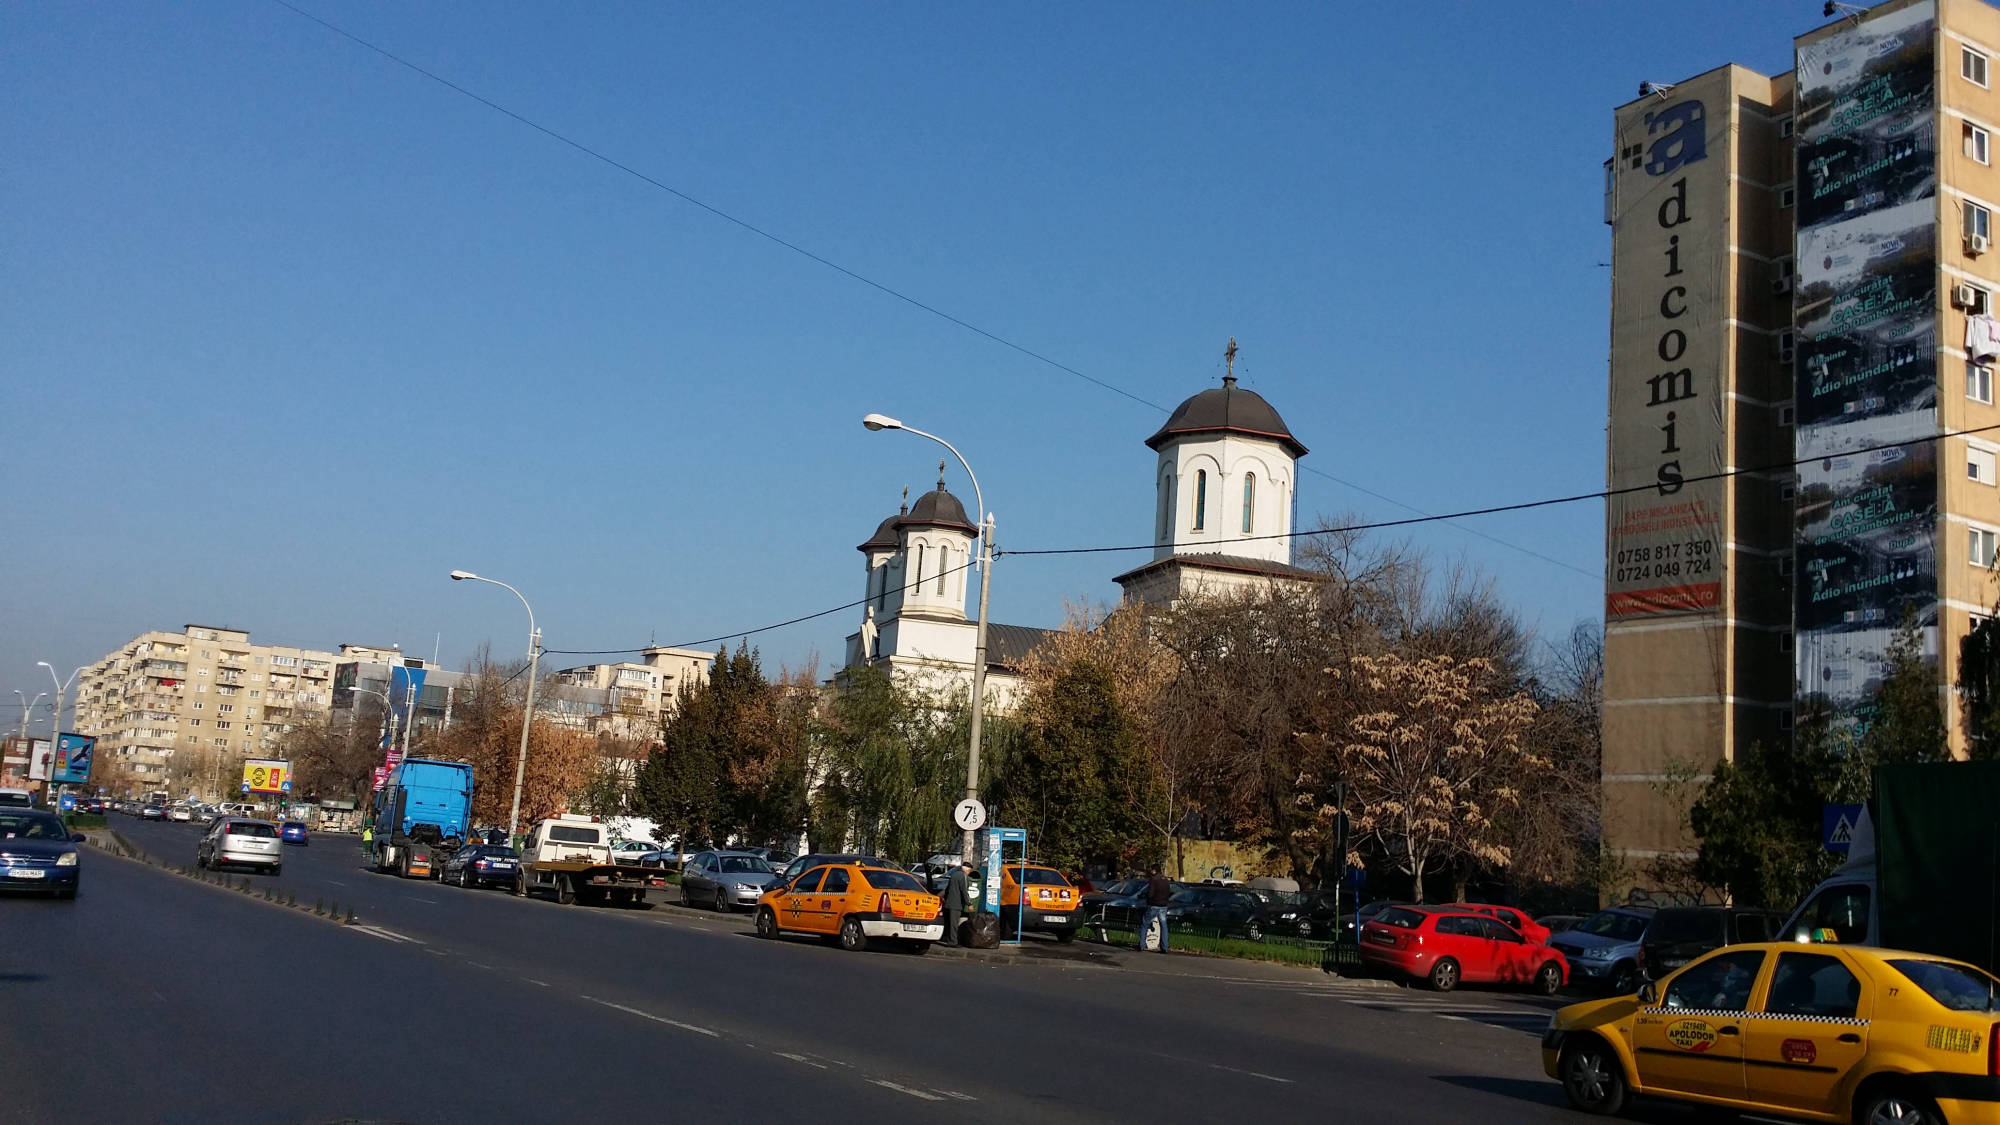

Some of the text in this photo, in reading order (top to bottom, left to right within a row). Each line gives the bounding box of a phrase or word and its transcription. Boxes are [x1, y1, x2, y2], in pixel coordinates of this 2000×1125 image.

[1813, 181, 1841, 200] Adio
[1813, 380, 1841, 398] Adio
[1617, 540, 1711, 564] 0758 817 350
[1617, 558, 1711, 582] 0724 049 724
[1813, 586, 1841, 602] Adio
[1889, 988, 1899, 997] 77
[1669, 1030, 1714, 1041] APOLODOR
